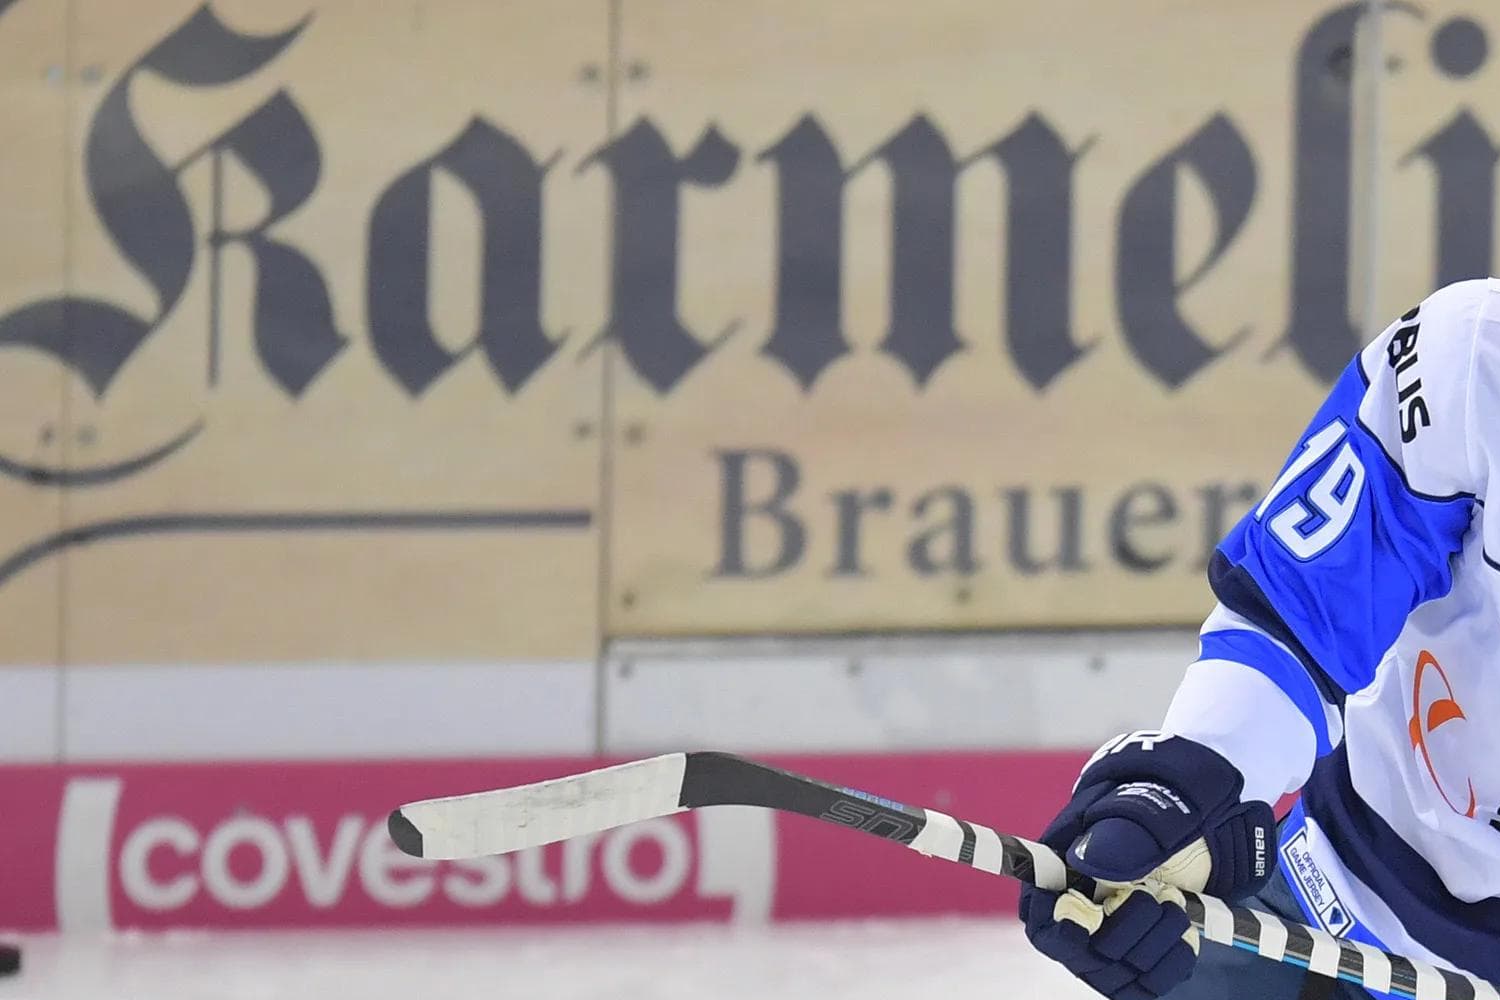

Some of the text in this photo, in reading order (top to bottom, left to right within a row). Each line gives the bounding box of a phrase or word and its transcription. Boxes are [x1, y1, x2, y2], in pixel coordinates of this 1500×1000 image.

[1255, 417, 1367, 562] 19
[1289, 847, 1326, 907] GAME JERSEY
[1302, 851, 1326, 892] OFFICIAL
